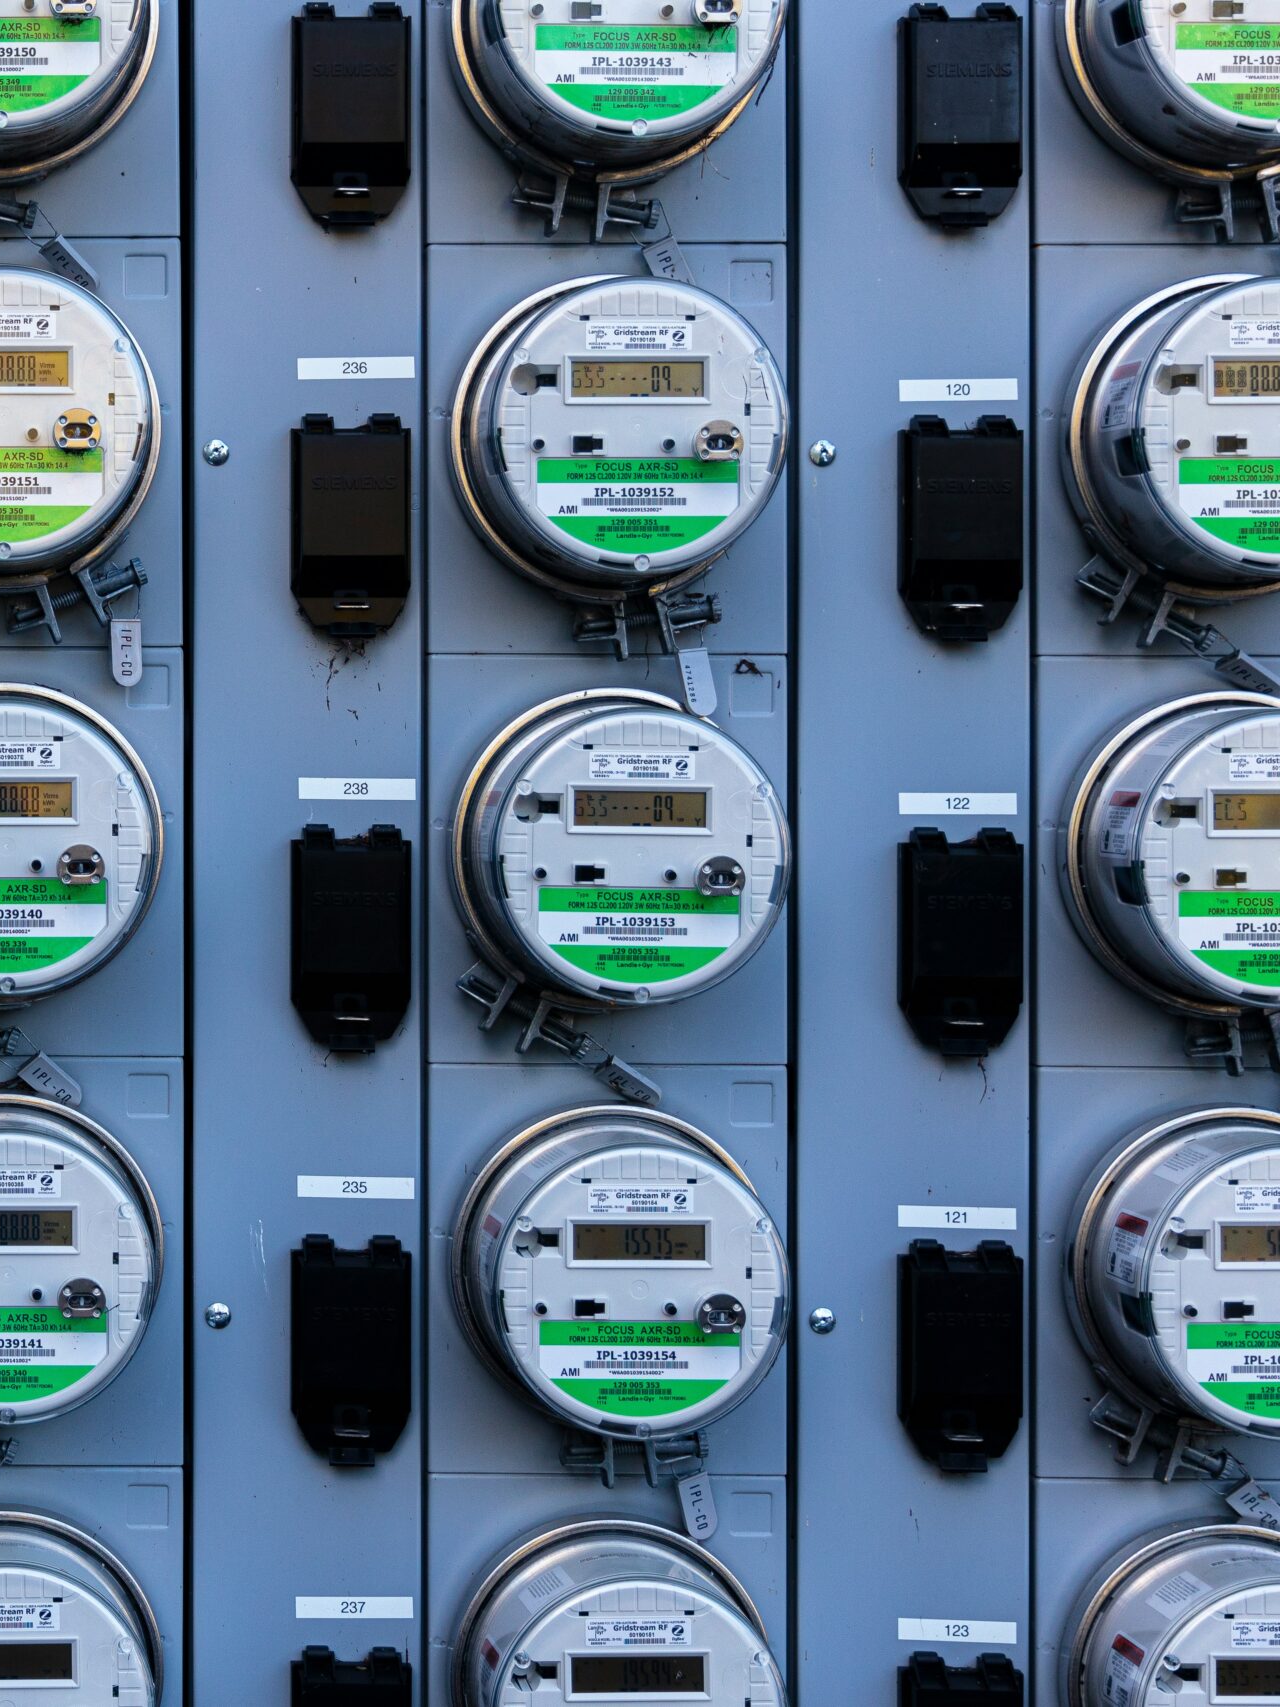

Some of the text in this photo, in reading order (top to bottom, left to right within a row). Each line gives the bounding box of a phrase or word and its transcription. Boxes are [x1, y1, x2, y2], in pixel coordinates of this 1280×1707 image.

[0, 22, 41, 32] AXR-SD
[593, 31, 677, 42] FOCUS AXR-SD
[1234, 30, 1271, 39] FOCUS
[592, 56, 672, 67] IPL-1039143
[312, 62, 398, 78] SIEMENS
[926, 62, 1013, 79] SIEMENS
[556, 74, 576, 83] AMI
[1196, 72, 1216, 82] AMI
[342, 362, 368, 374] 236
[946, 384, 970, 396] 120
[3, 452, 45, 461] AXR-SD
[596, 462, 679, 472] FOCUS AXR-SD
[1237, 464, 1274, 474] FOCUS
[594, 487, 675, 498] IPL-1039152
[558, 505, 578, 514] AMI
[1200, 508, 1220, 517] AMI
[121, 629, 133, 676] IPL-CO
[617, 758, 672, 766] Gridstream RF
[344, 782, 368, 794] 238
[946, 798, 970, 810] 122
[6, 884, 47, 894] AXR-SD
[597, 891, 680, 902] FOCUS AXR-SD
[1237, 897, 1274, 907] FOCUS
[595, 916, 676, 928] IPL-1039153
[559, 933, 579, 942] AMI
[1200, 941, 1220, 950] AMI
[32, 1067, 72, 1102] IPL-CO
[342, 1180, 368, 1194] 235
[616, 1192, 658, 1200] Gridstream
[946, 1212, 966, 1224] 121
[7, 1314, 48, 1323] AXR-SD
[598, 1325, 681, 1335] FOCUS AXR-SD
[596, 1350, 677, 1361] IPL-1039154
[560, 1368, 580, 1377] AMI
[1209, 1372, 1228, 1382] AMI
[689, 1484, 708, 1530] IPL-CO
[26, 1608, 36, 1616] RF
[340, 1602, 366, 1614] 237
[613, 1624, 668, 1632] Gridstream RF
[946, 1624, 970, 1638] 123
